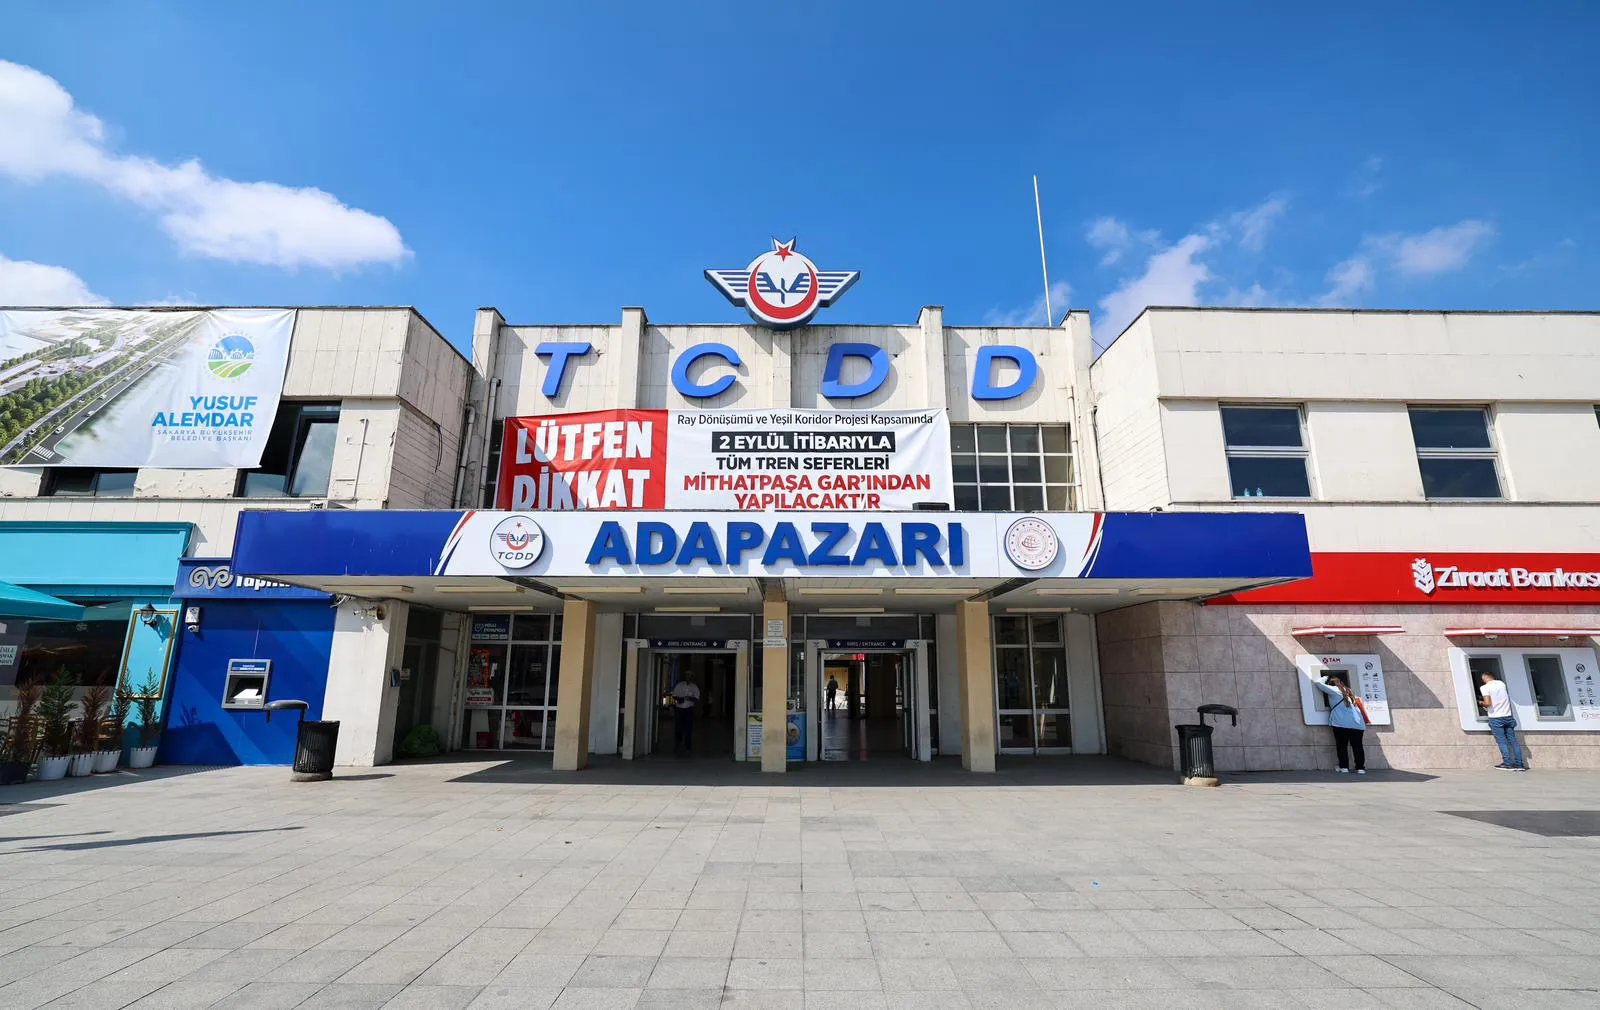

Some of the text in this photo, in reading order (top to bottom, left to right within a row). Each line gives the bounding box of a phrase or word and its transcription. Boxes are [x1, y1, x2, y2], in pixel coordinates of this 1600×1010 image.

[190, 395, 258, 411] YUSUF
[152, 411, 254, 428] ALEMDAR
[677, 413, 933, 427] Ray Dönüşümü ve Yeşil Koridor Projesi Kapsamında
[515, 419, 653, 464] LÜTFEN
[719, 433, 892, 450] 2 EYLÜL İTİBARIYLA
[716, 454, 890, 471] TÜM TREN SEFERLERİ
[511, 466, 651, 511] DİKKAT
[684, 472, 813, 493] MİTHATPAŞA
[586, 522, 964, 566] ADAPAZARI
[498, 551, 535, 560] TCDD
[1435, 566, 1511, 588] Ziraat
